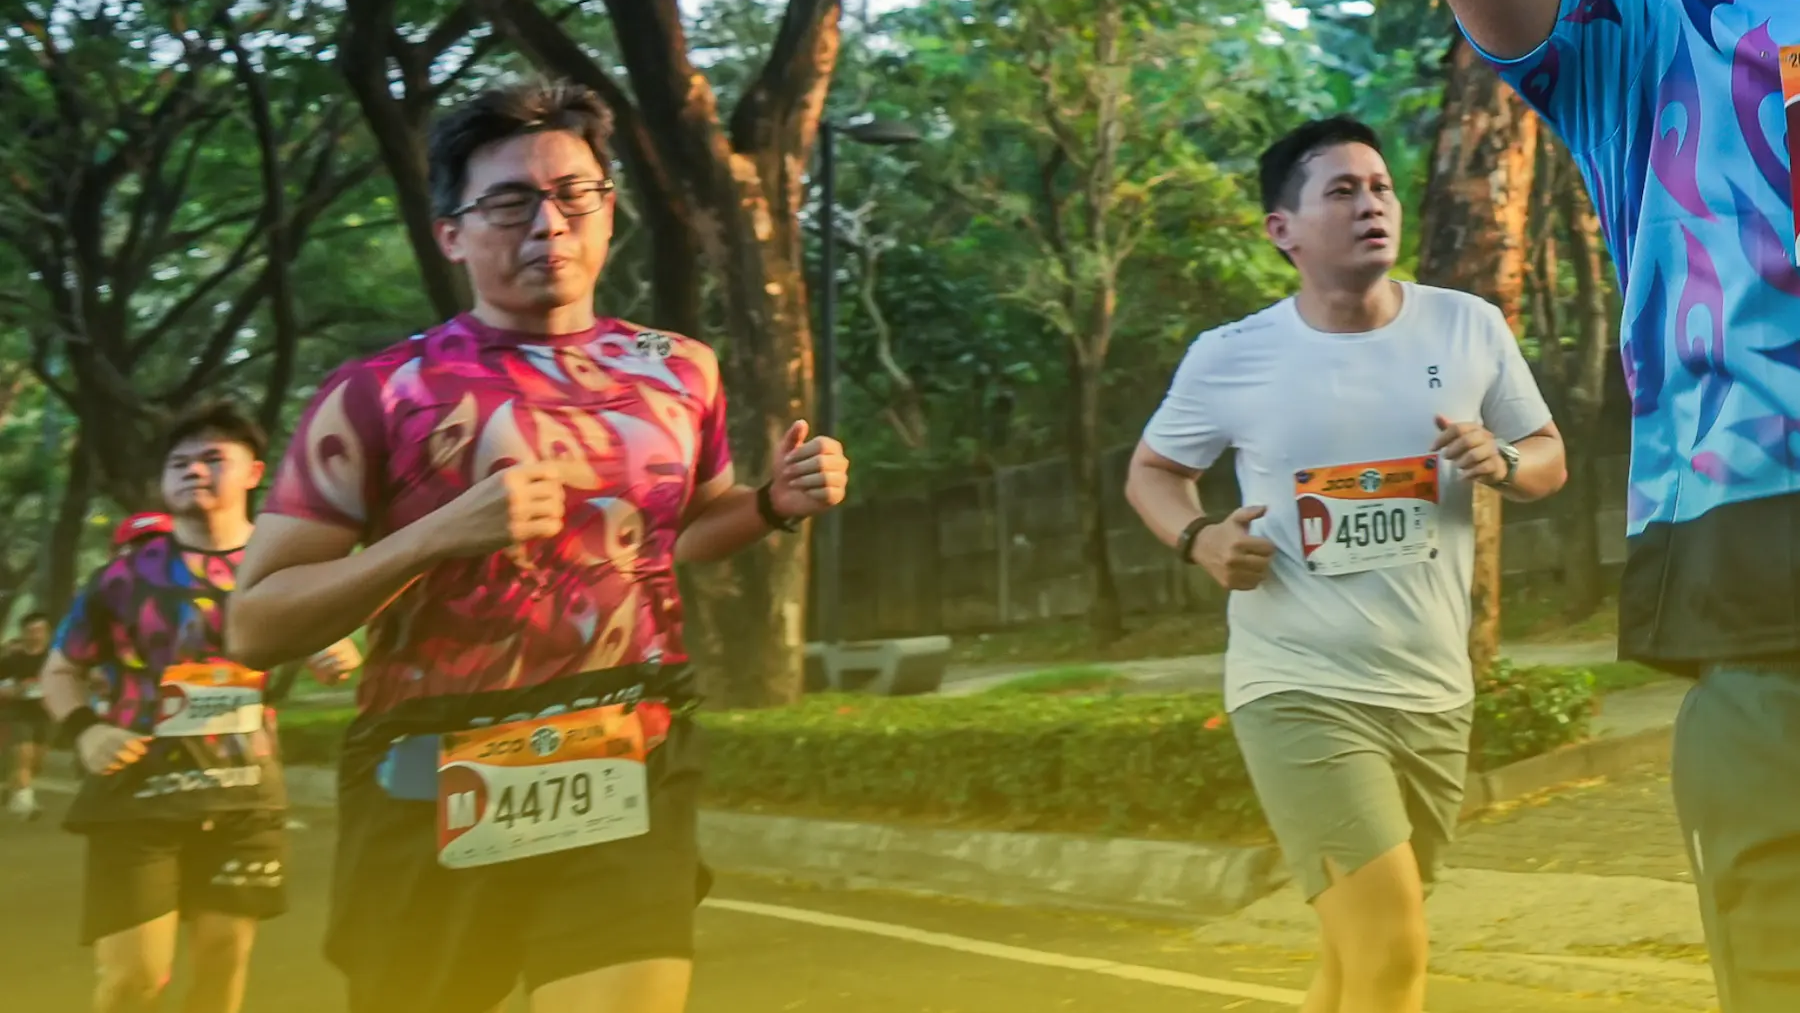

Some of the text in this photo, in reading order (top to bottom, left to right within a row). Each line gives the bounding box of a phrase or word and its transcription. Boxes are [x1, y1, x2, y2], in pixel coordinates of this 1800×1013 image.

[1302, 516, 1324, 546] M
[1335, 507, 1406, 550] 4500
[447, 790, 476, 831] M
[492, 771, 593, 830] 4479
